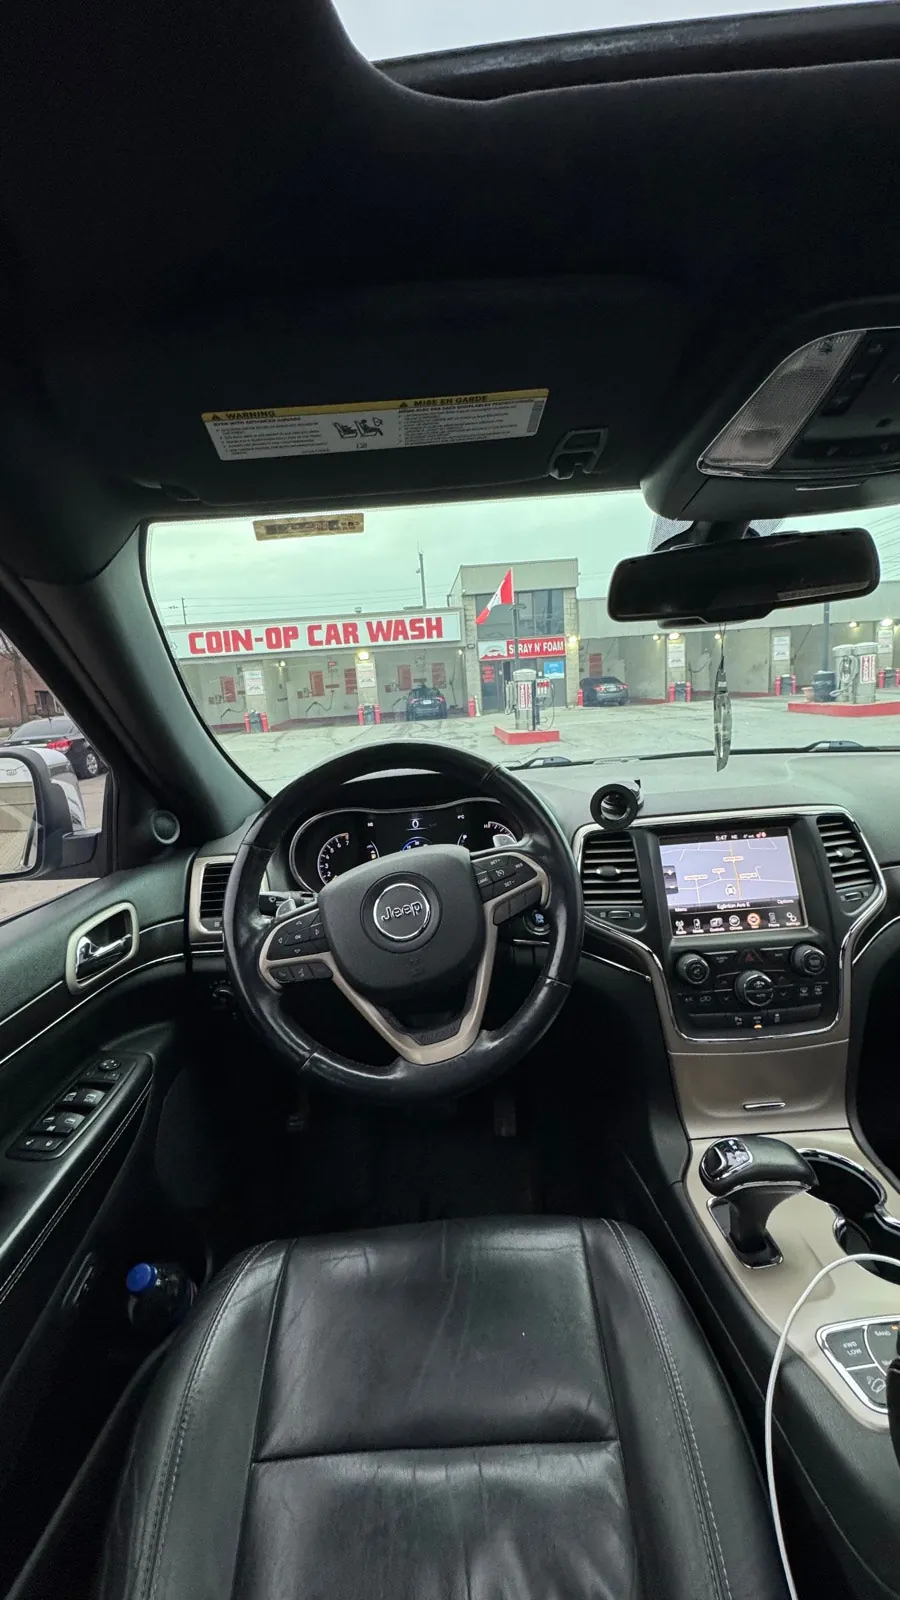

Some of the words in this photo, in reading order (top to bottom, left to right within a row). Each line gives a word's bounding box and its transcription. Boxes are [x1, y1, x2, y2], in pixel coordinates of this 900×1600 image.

[414, 399, 436, 407] MISE
[455, 395, 488, 403] GARDE
[226, 410, 275, 420] WARNING
[188, 626, 299, 654] COIN-OP
[307, 622, 360, 646] CAR
[365, 616, 443, 643] WASH
[508, 643, 533, 655] SRAY
[543, 640, 564, 653] FOAM
[381, 901, 423, 921] Jeep
[843, 1340, 858, 1349] 4WD
[846, 1348, 862, 1356] LOW
